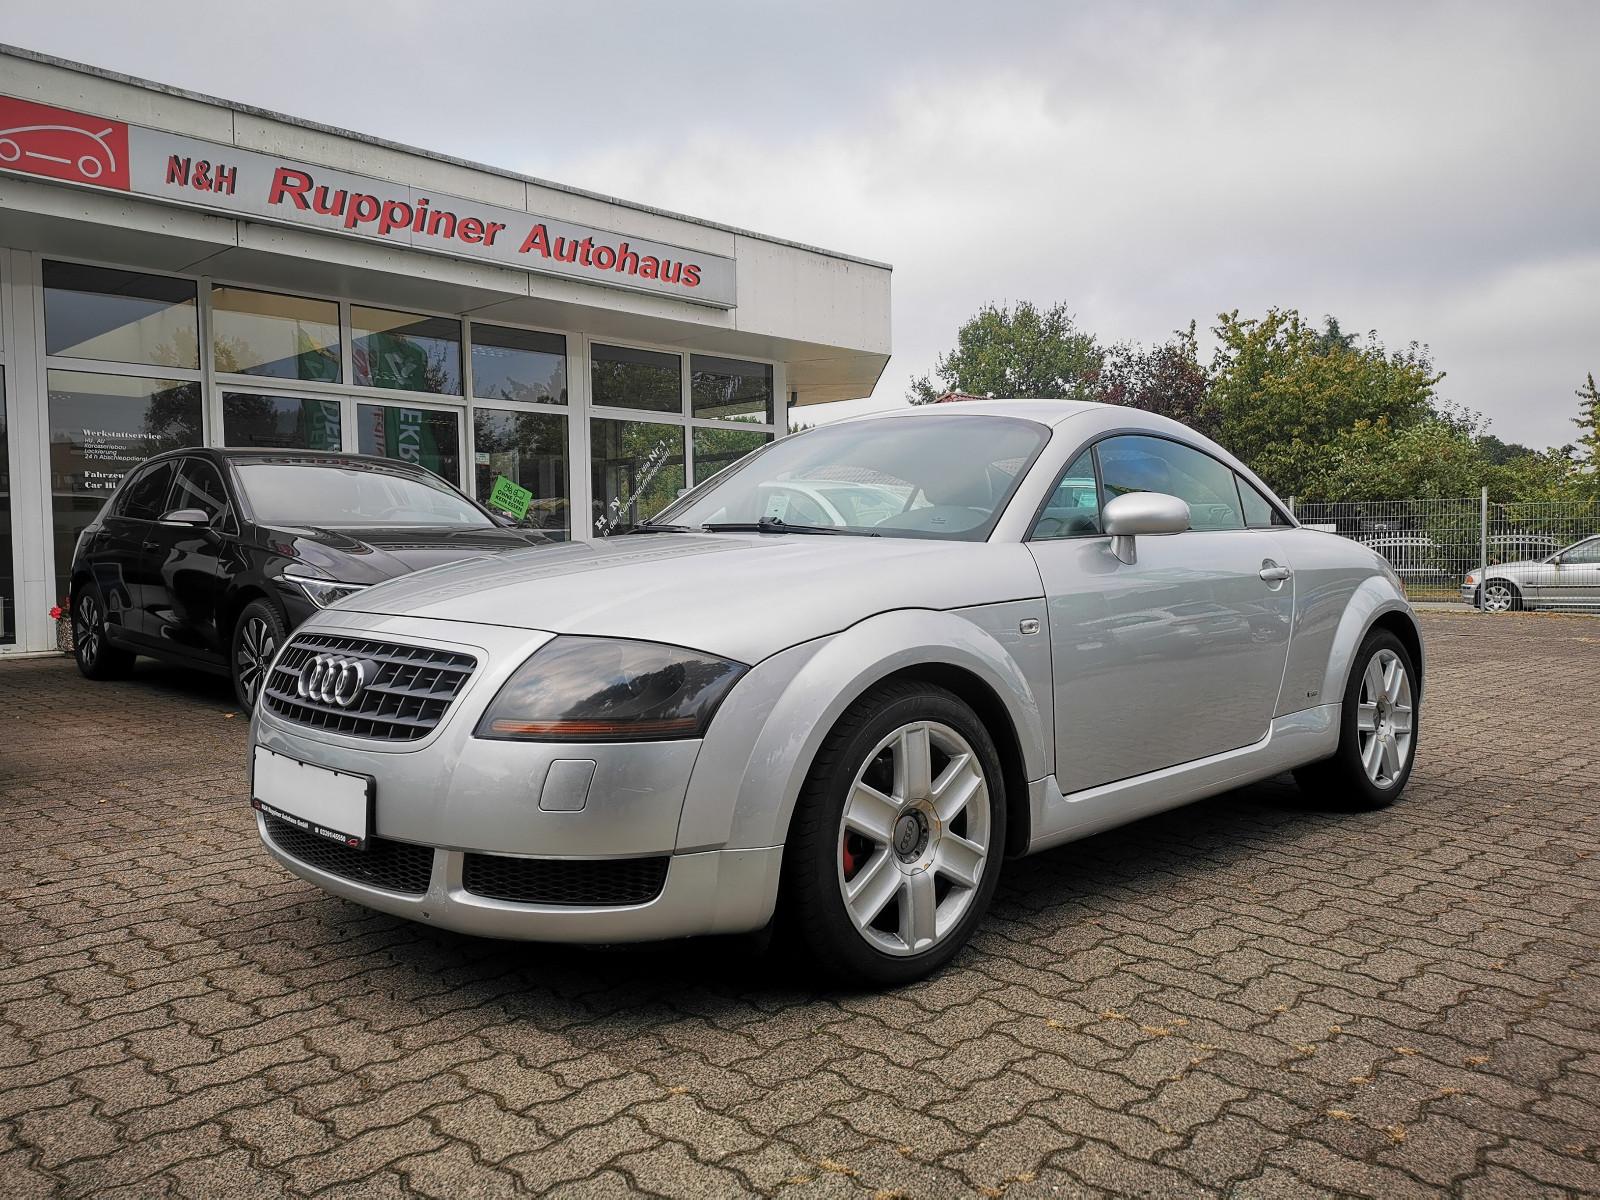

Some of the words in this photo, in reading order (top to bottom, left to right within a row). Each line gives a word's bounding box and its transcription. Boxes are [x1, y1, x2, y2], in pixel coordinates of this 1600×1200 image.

[166, 155, 237, 195] N&H
[268, 166, 506, 246] Ruppiner
[519, 223, 702, 287] Autohaus
[83, 429, 161, 440] Werkstattservice
[84, 470, 124, 479] Fahrzeu
[85, 481, 103, 489] Car
[495, 495, 508, 504] KEIN
[507, 500, 523, 512] ESSEN
[497, 489, 513, 500] OHNE
[512, 496, 525, 507] UNS
